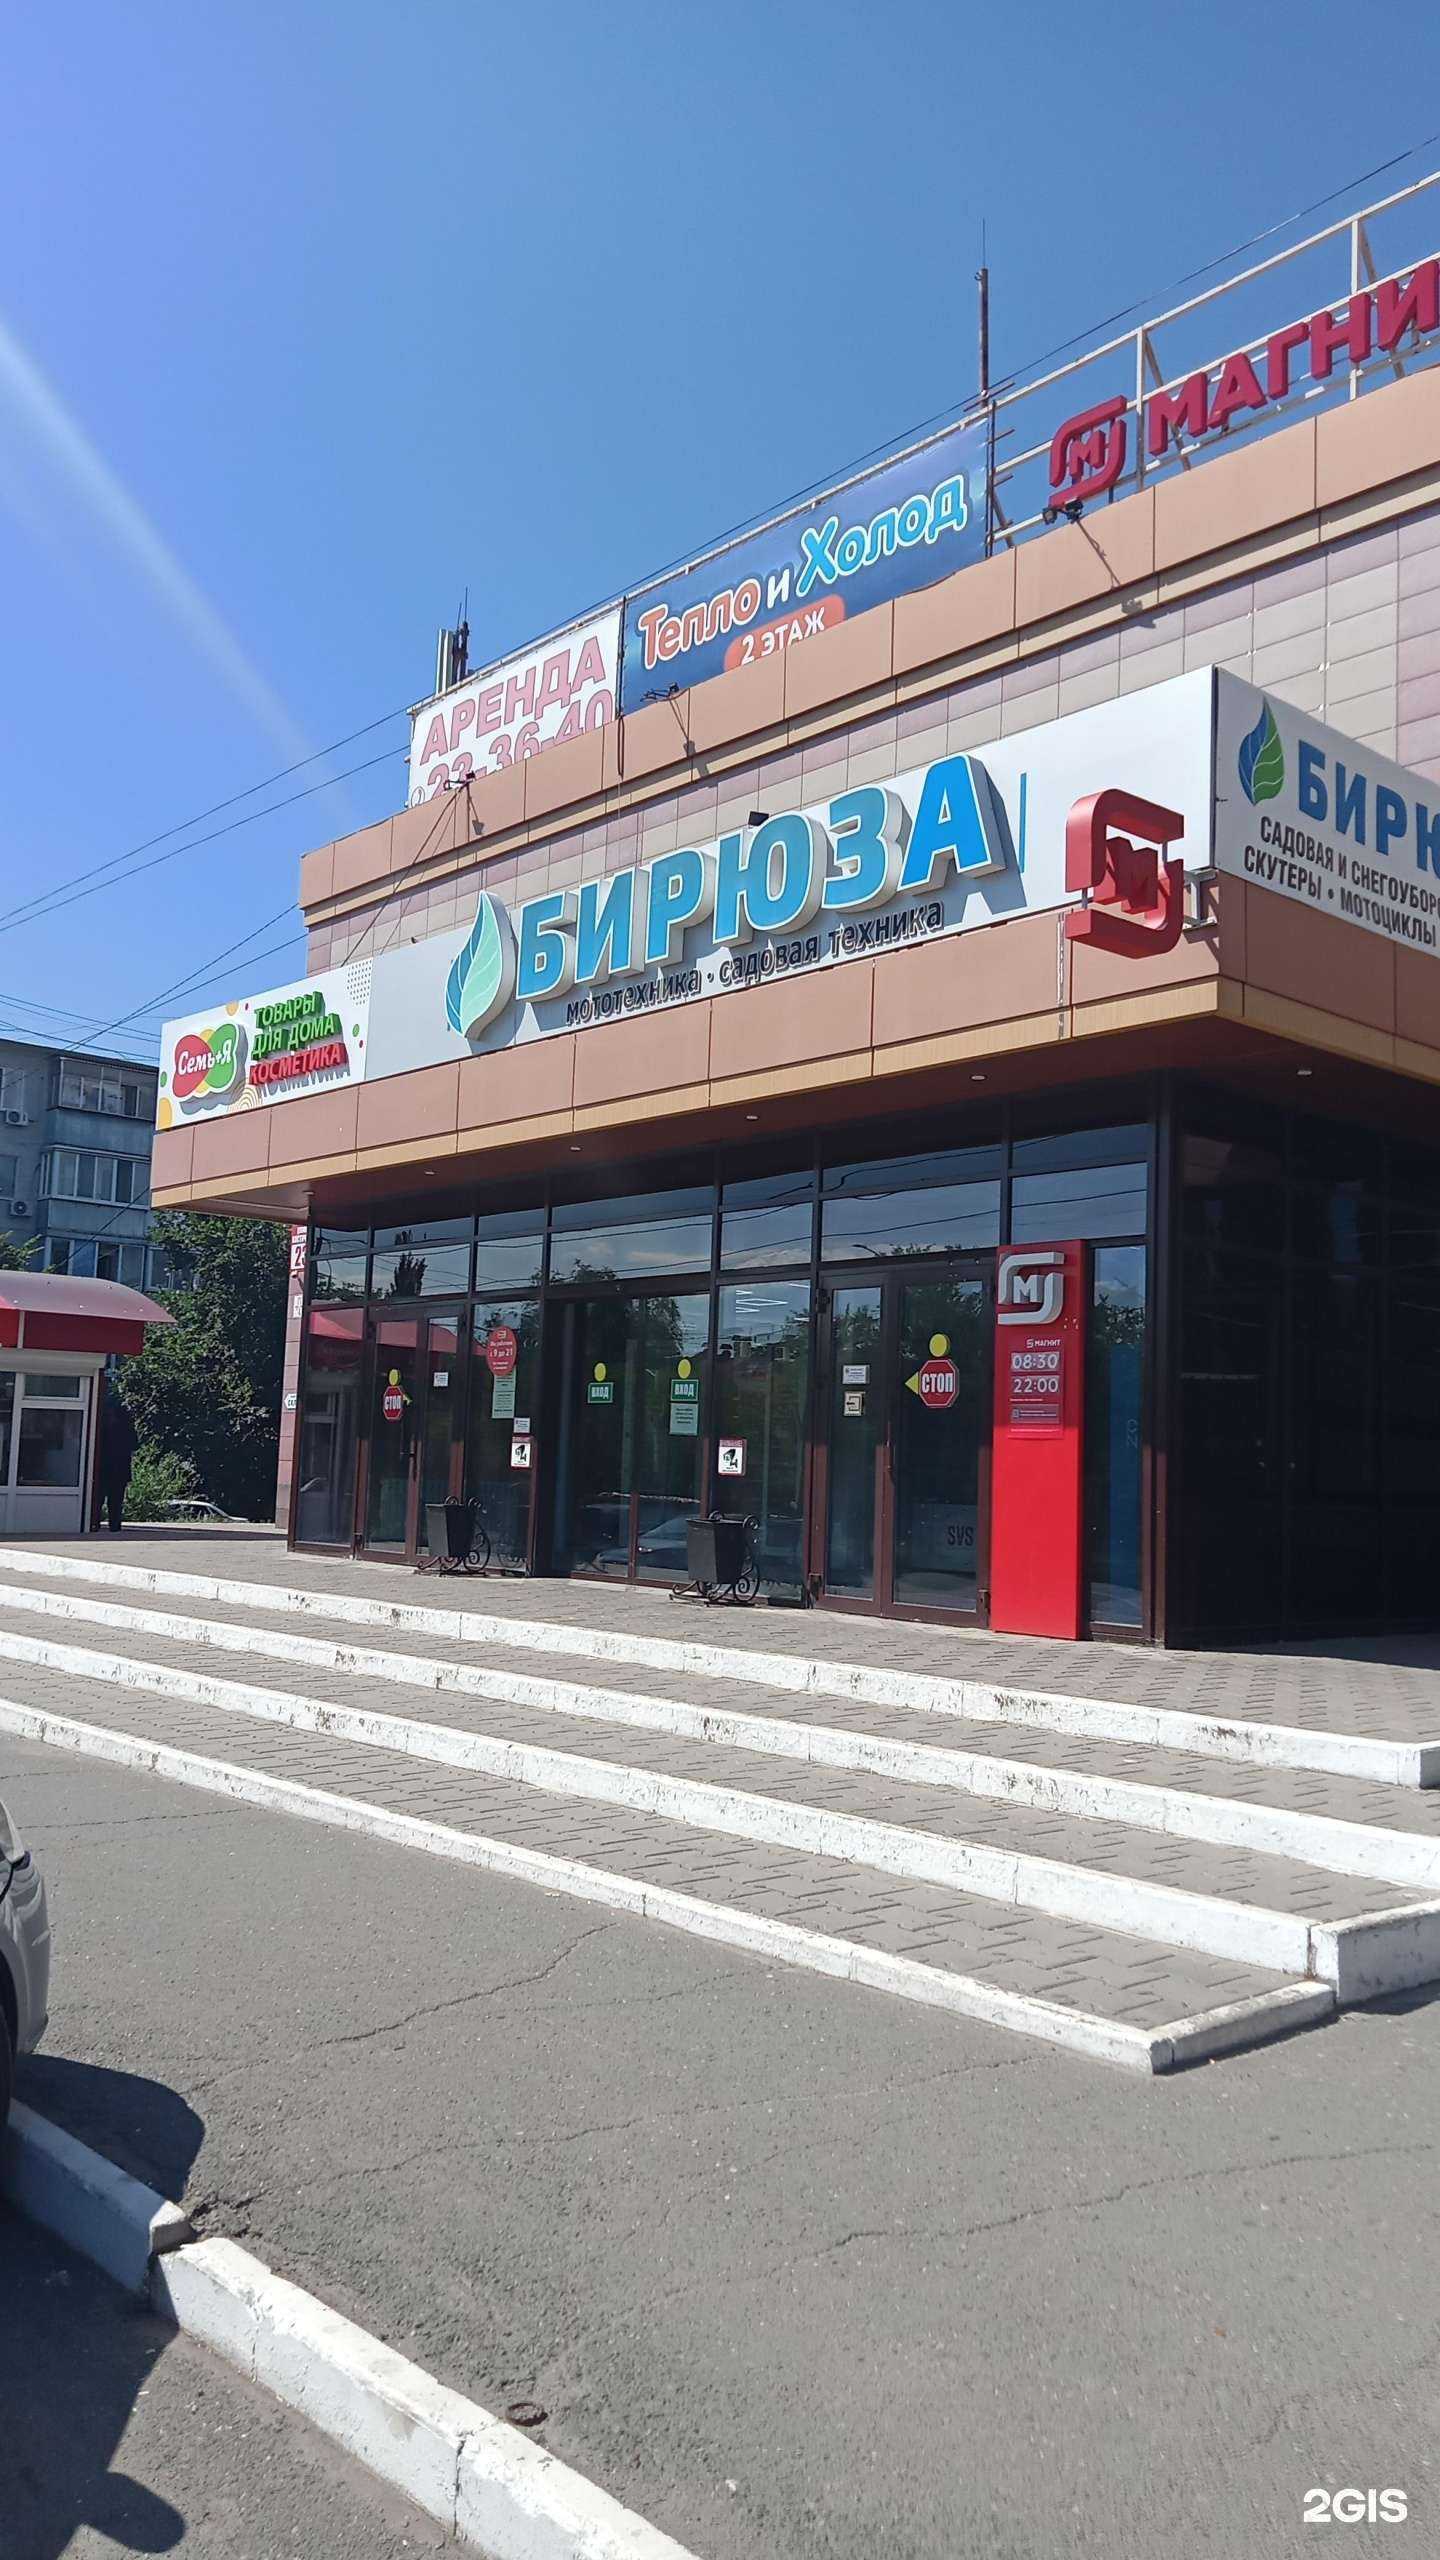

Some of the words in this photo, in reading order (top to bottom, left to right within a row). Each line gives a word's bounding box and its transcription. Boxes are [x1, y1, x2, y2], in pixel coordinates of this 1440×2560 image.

[1147, 258, 1440, 457] МАГНИ
[638, 578, 761, 670] Тепло
[766, 568, 790, 609] и
[797, 474, 968, 598] Холод
[741, 634, 755, 667] 2
[763, 606, 825, 657] ЭТАЖ
[420, 635, 606, 766] АРЕНДА
[1260, 815, 1335, 873] САДОВАЯ
[1338, 852, 1348, 880] И
[515, 753, 993, 1001] БИРЮЗА
[1243, 845, 1322, 901] СКУТЕРЫ
[1340, 887, 1437, 948] МОТОЦИКЛЫ
[565, 967, 701, 1026] мототехника
[718, 936, 821, 988] садовая
[829, 899, 945, 958] техника
[251, 1027, 287, 1061] ДЛЯ
[288, 1013, 340, 1050] ДОМА
[254, 992, 322, 1029] ТОВАРЫ
[249, 1043, 348, 1086] КОСМЕТИКА
[921, 1372, 954, 1394] СТОП
[1012, 1354, 1059, 1370] 08:30
[1013, 1378, 1059, 1394] 22:00
[384, 1395, 402, 1410] СТОП
[947, 1526, 974, 1546] SVS
